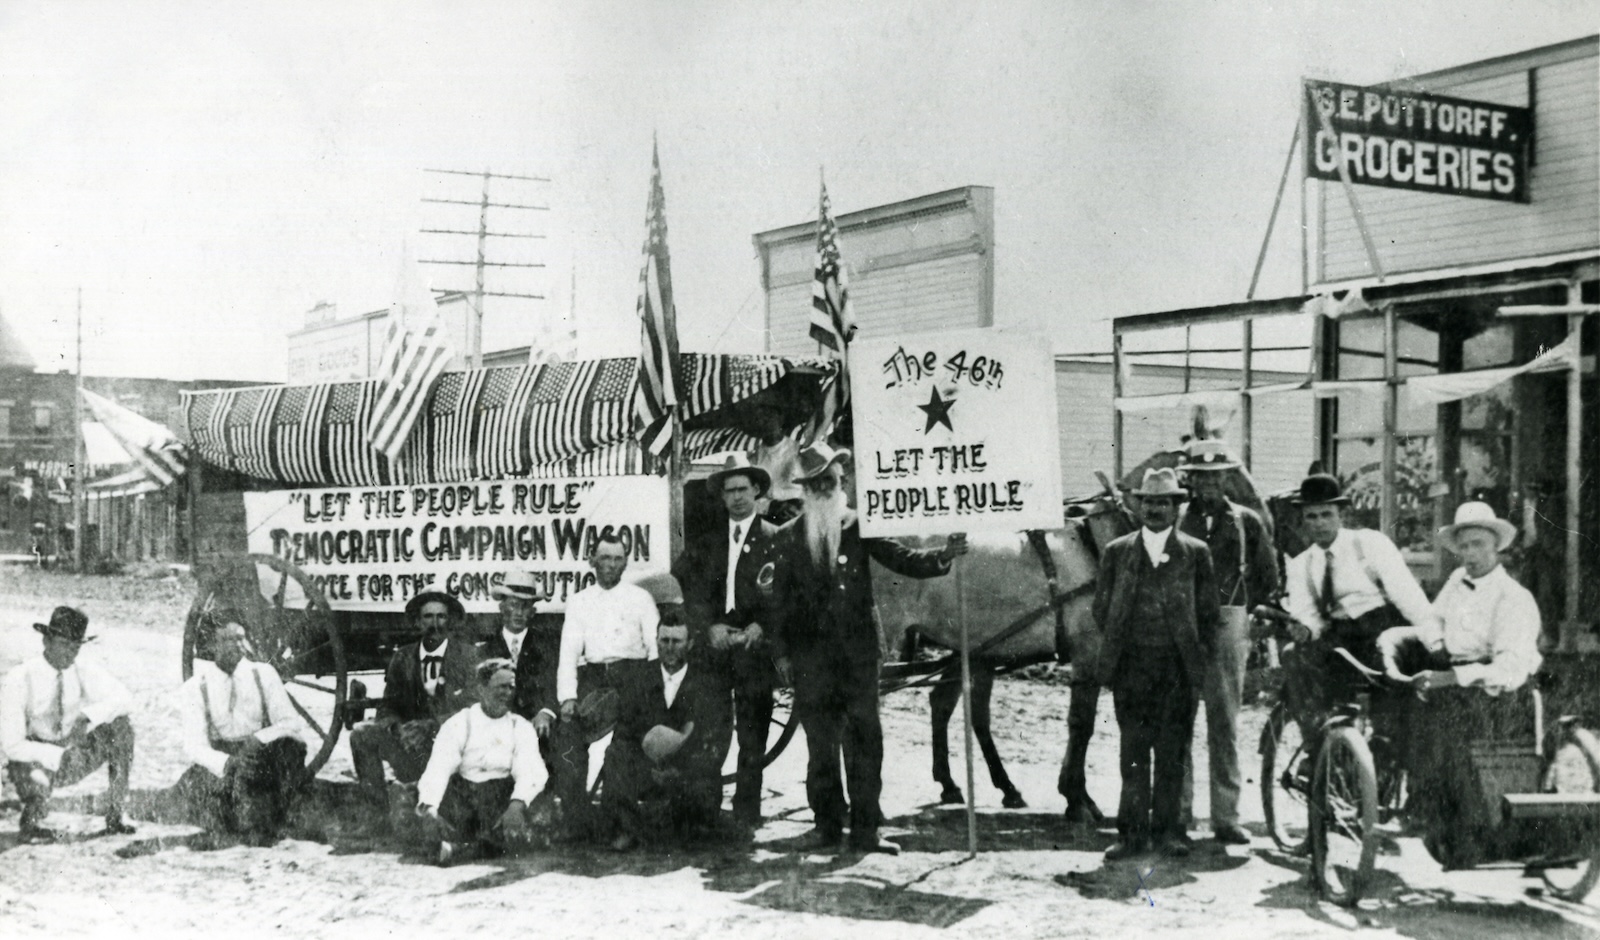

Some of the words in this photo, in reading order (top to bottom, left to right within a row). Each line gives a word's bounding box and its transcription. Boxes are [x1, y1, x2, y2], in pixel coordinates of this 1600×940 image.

[1315, 130, 1516, 194] GROCERIES
[883, 346, 937, 389] The
[943, 350, 1005, 388] 46th
[875, 448, 924, 479] LET
[929, 443, 987, 474] THE
[289, 492, 351, 523] "LET
[359, 489, 406, 520] THE
[412, 484, 505, 517] PEOPLE
[512, 480, 595, 514] RULE"
[865, 486, 950, 522] PEOPLE
[270, 527, 415, 565] DEMOCRATIC
[420, 521, 547, 562] CAMPAIGN
[309, 573, 352, 600] OTE
[356, 573, 394, 601] FOR
